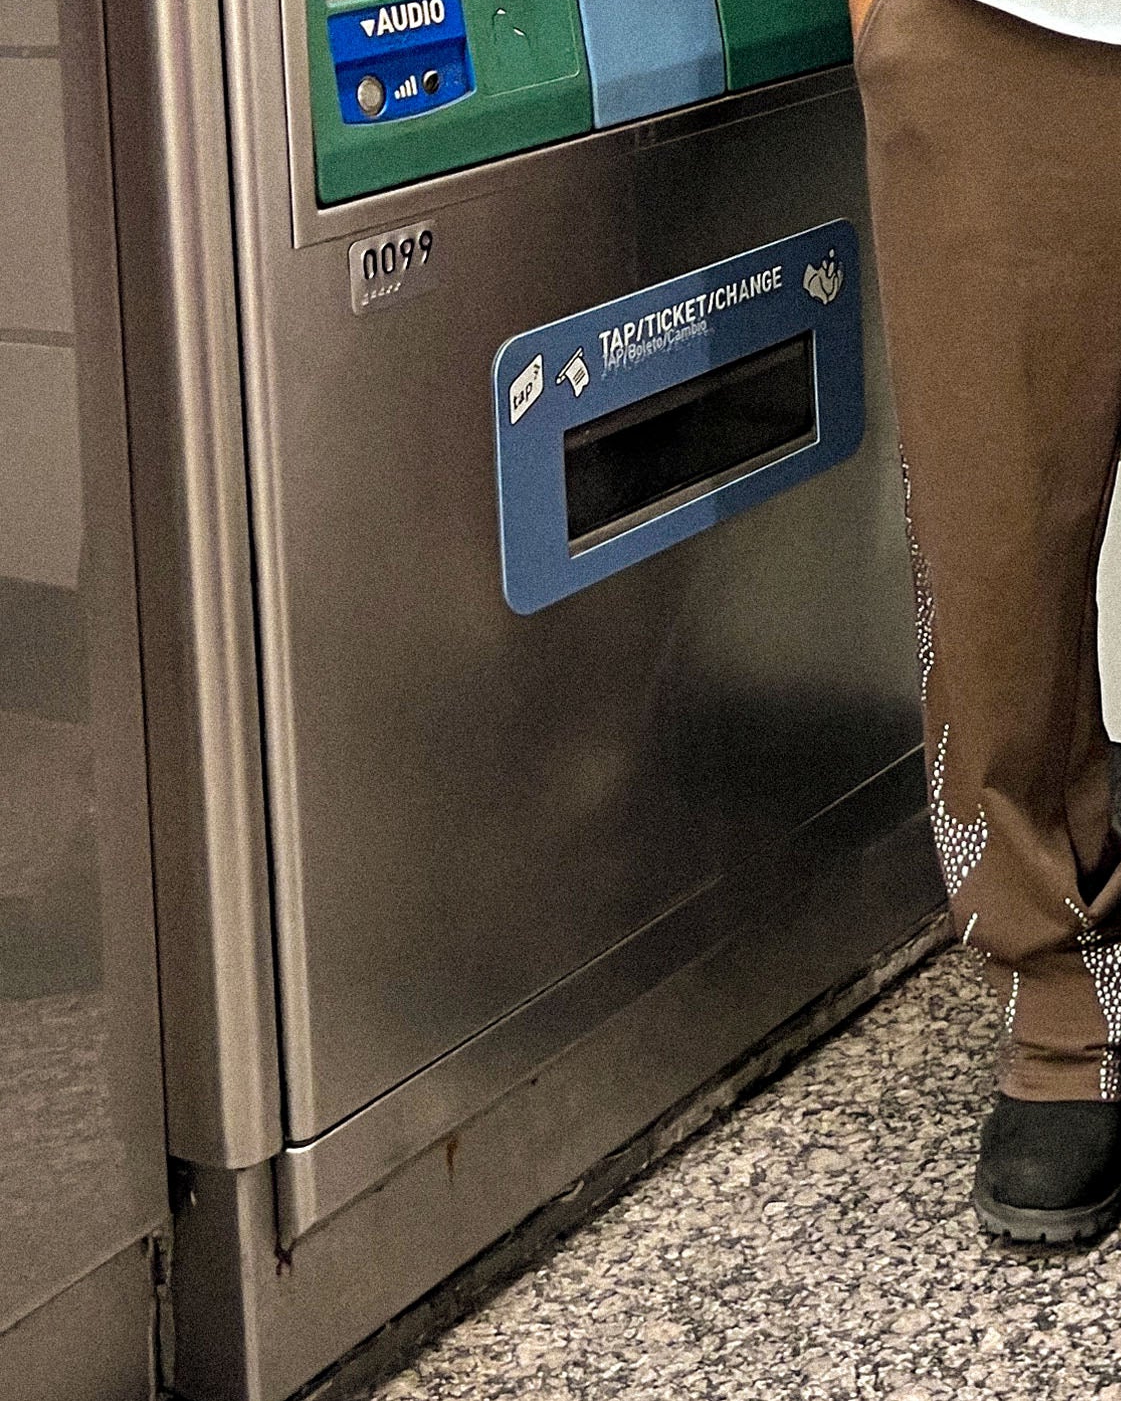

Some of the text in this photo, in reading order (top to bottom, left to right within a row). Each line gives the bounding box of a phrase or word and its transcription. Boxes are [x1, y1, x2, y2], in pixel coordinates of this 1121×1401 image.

[362, 229, 434, 280] 0099
[598, 265, 784, 356] TAP/TICKET/CHANGE
[512, 381, 533, 410] tap
